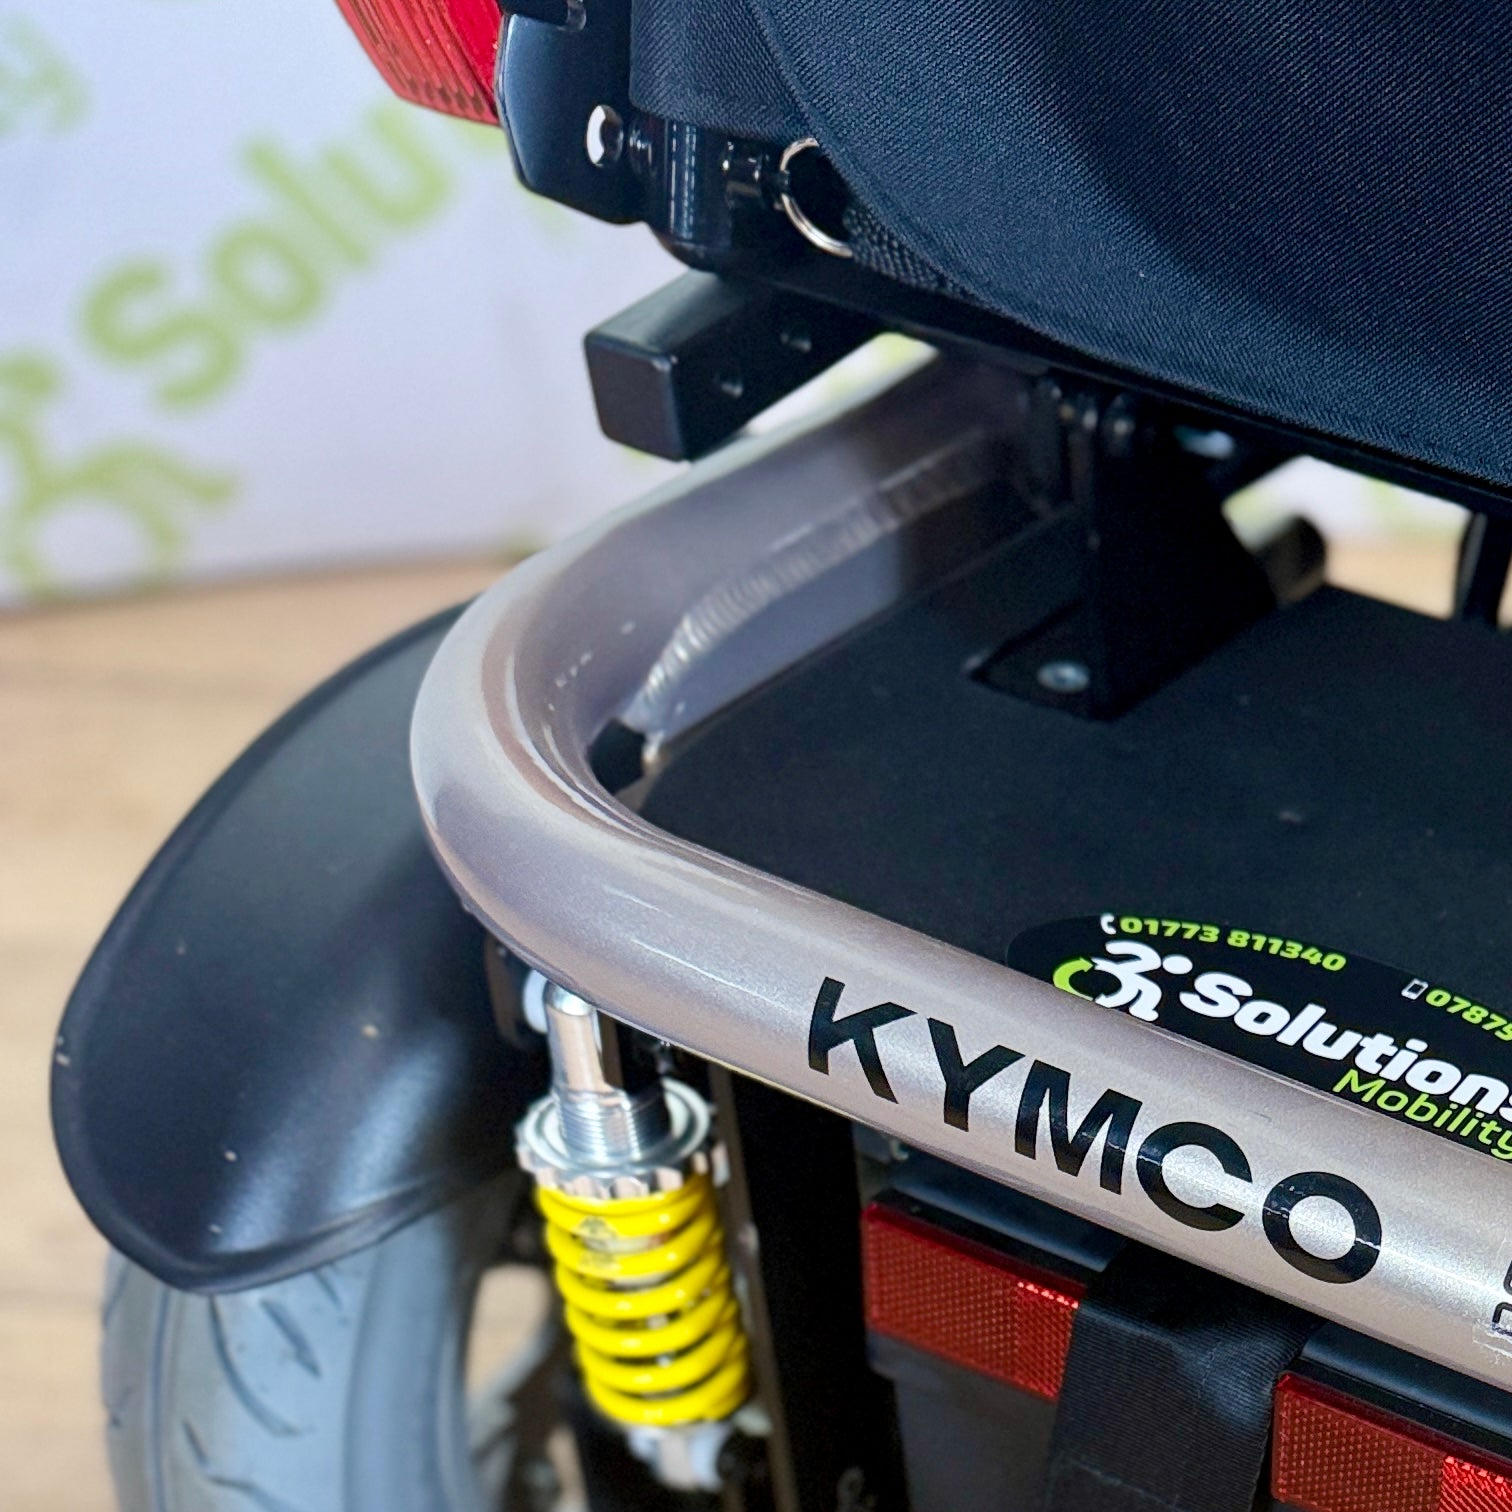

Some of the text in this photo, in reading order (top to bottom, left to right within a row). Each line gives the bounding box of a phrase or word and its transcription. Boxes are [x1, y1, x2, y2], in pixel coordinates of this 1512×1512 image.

[1119, 915, 1347, 972] 01773 811340
[807, 976, 1384, 1286] KYMCO
